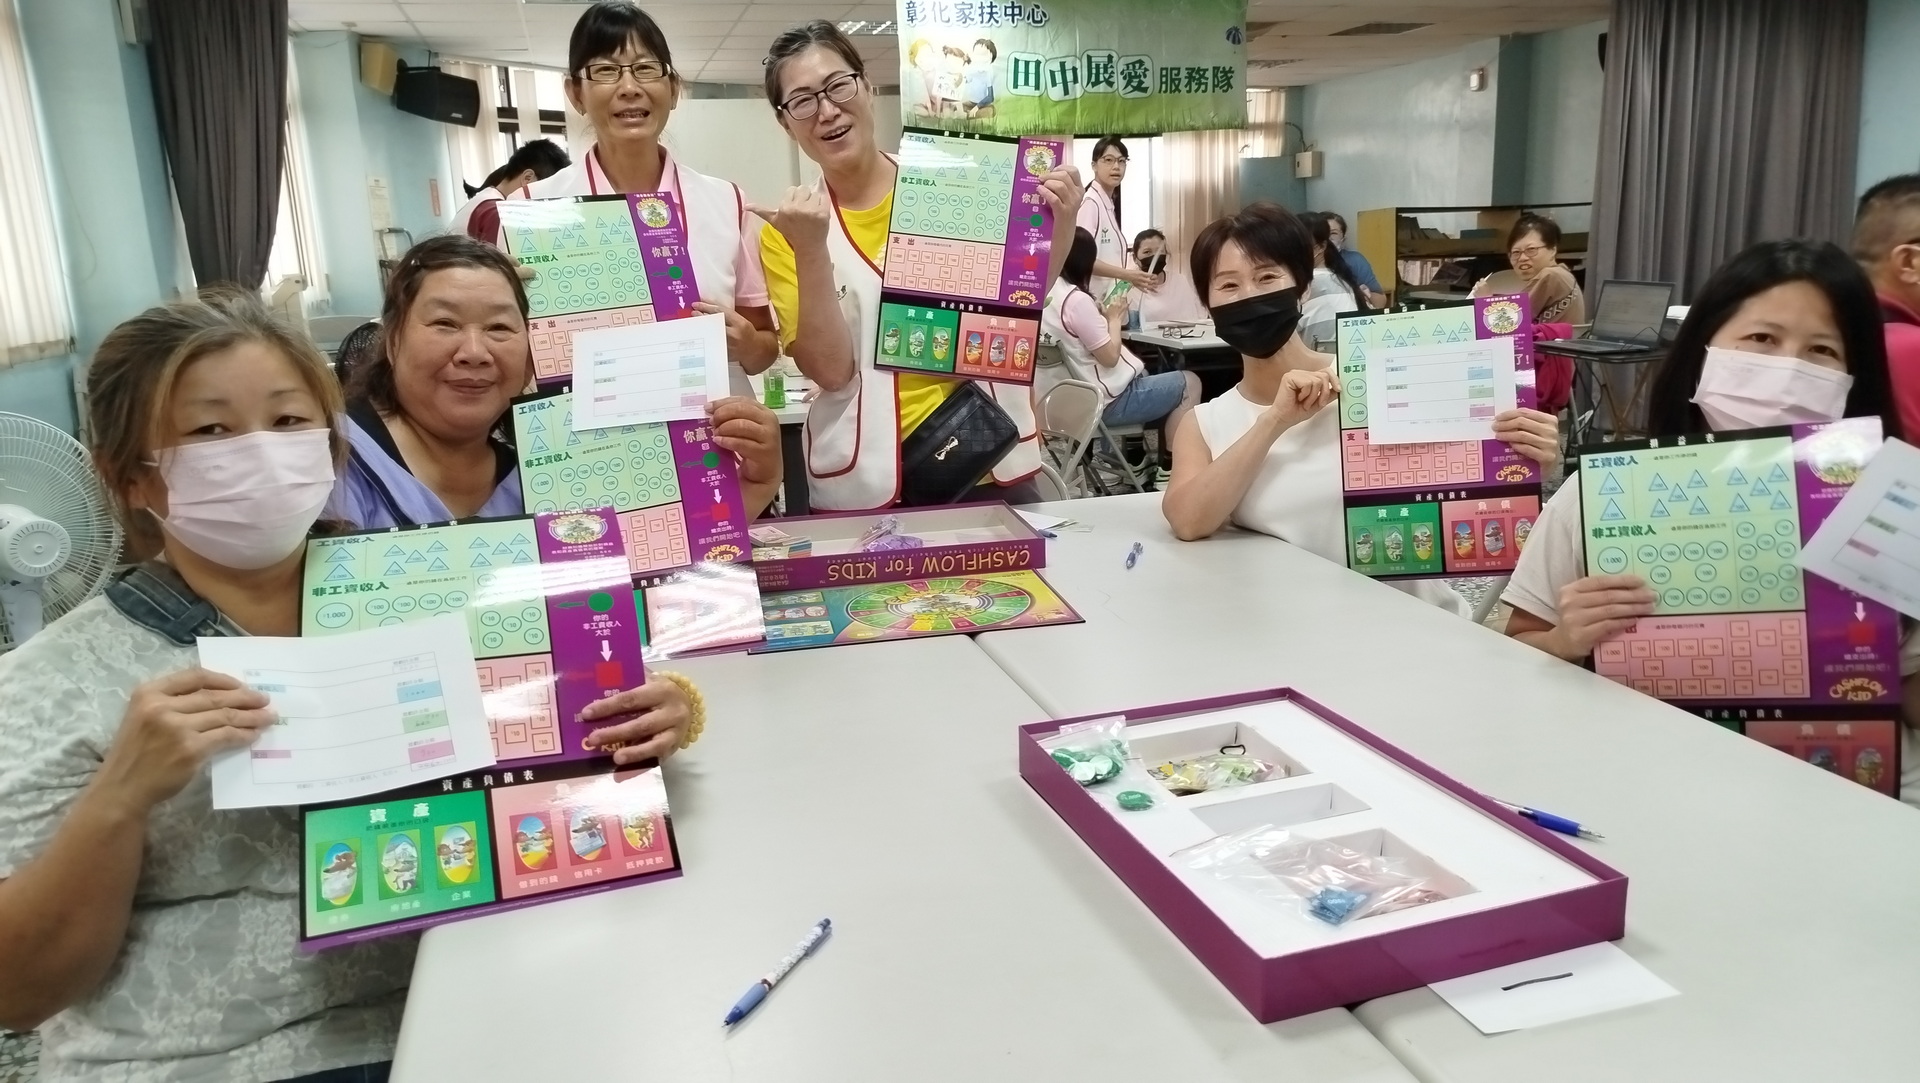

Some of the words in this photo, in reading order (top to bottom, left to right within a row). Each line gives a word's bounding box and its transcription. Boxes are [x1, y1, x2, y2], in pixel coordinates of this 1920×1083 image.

[906, 1, 1049, 26] 彰化家扶中心
[1342, 318, 1376, 328] 工資收入
[518, 400, 555, 415] 工資收入
[524, 451, 573, 469] 非工資收入
[1588, 455, 1639, 469] 工資收入
[1496, 464, 1533, 482] CASHFLOW
[1592, 524, 1657, 539] 非工資收入
[316, 536, 375, 548] 工資收入
[827, 561, 878, 581] KIDS
[884, 558, 914, 576] for
[922, 550, 1031, 575] CASHFLOW
[312, 581, 390, 598] 非工資收入
[442, 769, 534, 791] 資產負債表
